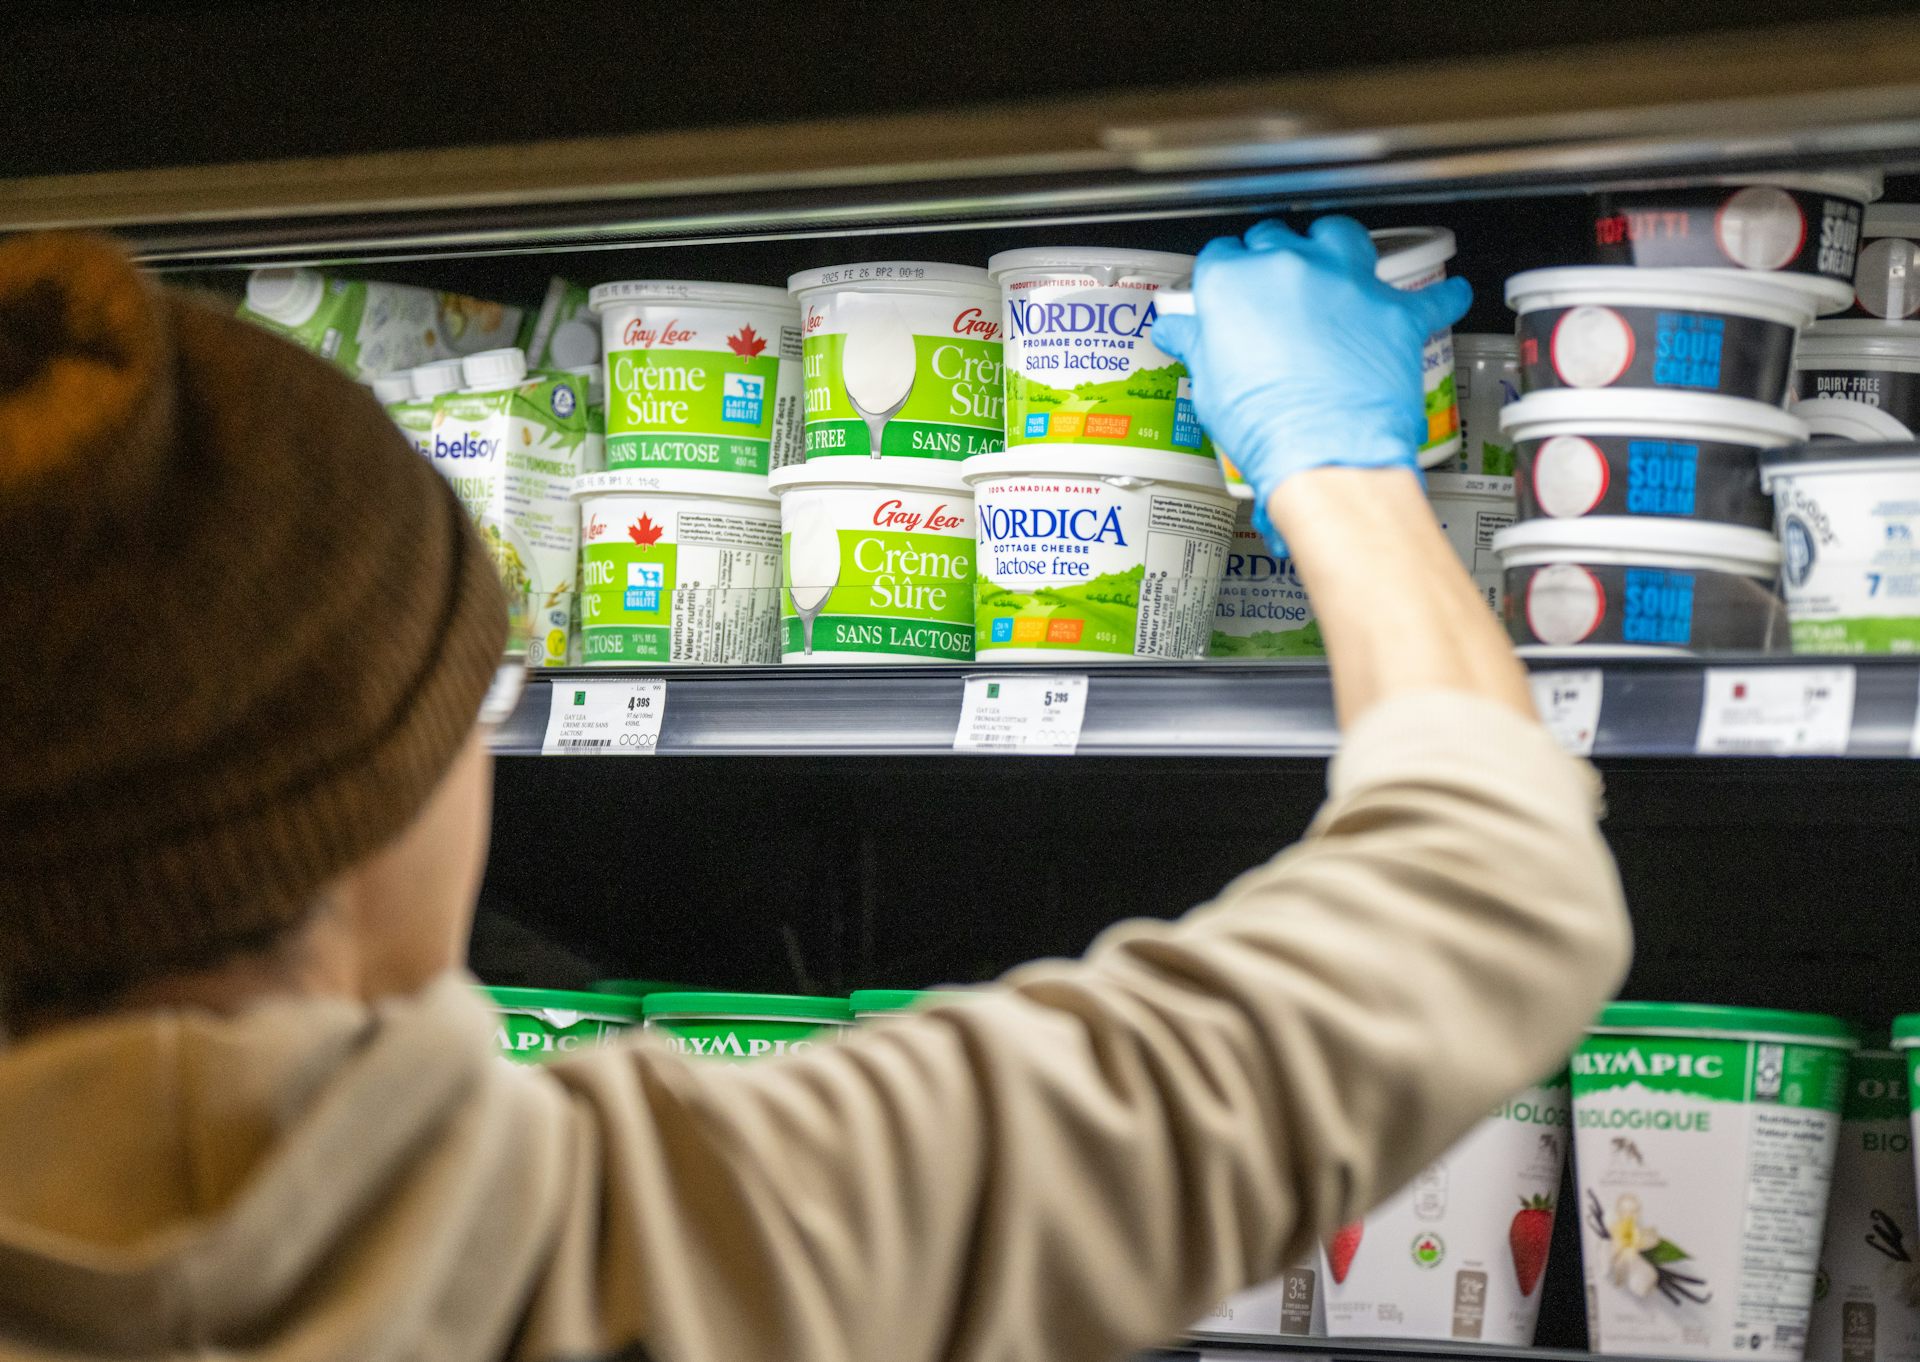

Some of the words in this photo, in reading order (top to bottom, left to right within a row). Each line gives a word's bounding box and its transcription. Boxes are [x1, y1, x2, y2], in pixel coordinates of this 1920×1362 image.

[843, 269, 854, 280] FE
[859, 268, 870, 278] 26
[875, 267, 893, 278] BP2
[1039, 279, 1077, 289] LAITIERS
[1079, 279, 1094, 287] 100
[623, 318, 656, 348] Gay
[659, 319, 692, 346] Lea
[953, 308, 999, 341] Gay
[1008, 298, 1158, 341] NORDICA
[1023, 337, 1070, 349] FROMAGE
[1074, 338, 1135, 350] COTTAGE
[1656, 330, 1724, 359] SOUR
[614, 357, 706, 393] Crème
[1026, 352, 1060, 371] sans
[1064, 350, 1130, 372] lactose
[1817, 376, 1880, 393] DAIRY-FREE
[626, 394, 689, 425] Sûre
[815, 428, 846, 449] FREE
[912, 430, 961, 453] SANS
[1138, 428, 1153, 438] 450
[1154, 431, 1159, 440] g
[1176, 424, 1190, 434] LAIT
[435, 431, 500, 462] belsoy
[610, 443, 638, 463] SANS
[641, 442, 720, 463] LACTOSE
[1629, 457, 1696, 488] SOUR
[988, 485, 1006, 495] 100%
[1009, 485, 1060, 494] CANADIAN
[1065, 485, 1102, 495] DAIRY
[873, 499, 922, 531] Gay
[923, 504, 960, 531] Lea
[979, 504, 1128, 547] NORDICA
[854, 537, 969, 580] Crème
[994, 544, 1037, 554] COTTAGE
[1041, 544, 1089, 554] CHEESE
[996, 557, 1046, 576] lactose
[1051, 557, 1090, 577] free
[869, 574, 947, 611] Sûre
[1865, 572, 1882, 596] 7
[1216, 603, 1235, 617] ns
[1240, 600, 1306, 621] lactose
[1625, 587, 1694, 617] SOUR
[673, 615, 683, 661] Nutrition
[684, 621, 695, 661] Valeur
[836, 624, 883, 645] SANS
[889, 626, 972, 653] LACTOSE
[1095, 631, 1111, 642] 450
[1111, 634, 1117, 645] g
[1137, 606, 1150, 654] Nutrition
[1148, 615, 1159, 654] Valeur
[1171, 625, 1180, 658] Calories
[712, 631, 720, 663] Calories
[628, 697, 635, 711] 4
[1044, 691, 1052, 706] 5
